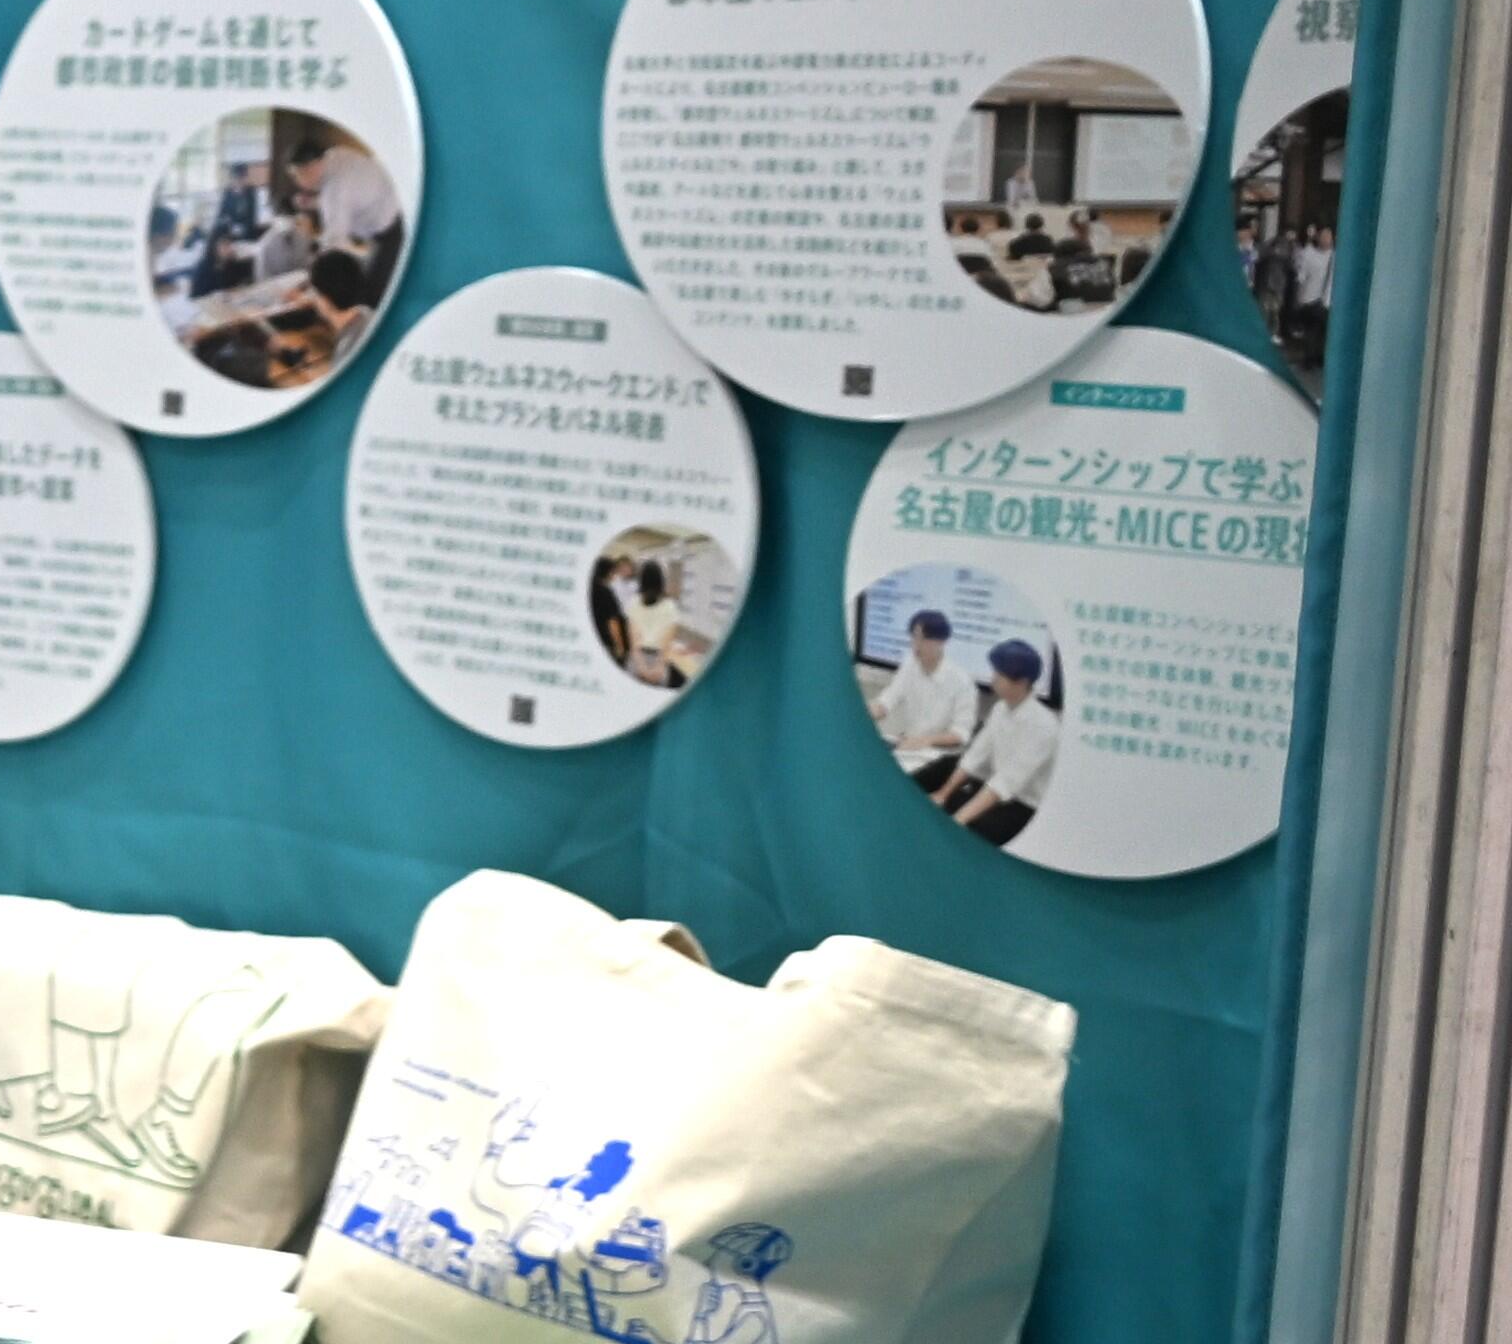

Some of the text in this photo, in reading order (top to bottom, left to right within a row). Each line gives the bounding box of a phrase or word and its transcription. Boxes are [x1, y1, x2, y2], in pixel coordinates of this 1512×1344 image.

[84, 16, 319, 51] カードゲームを通じて
[54, 55, 349, 92] 都市政策の価値判断を学ぶ
[924, 436, 1304, 502] インターンシップで学ぶ
